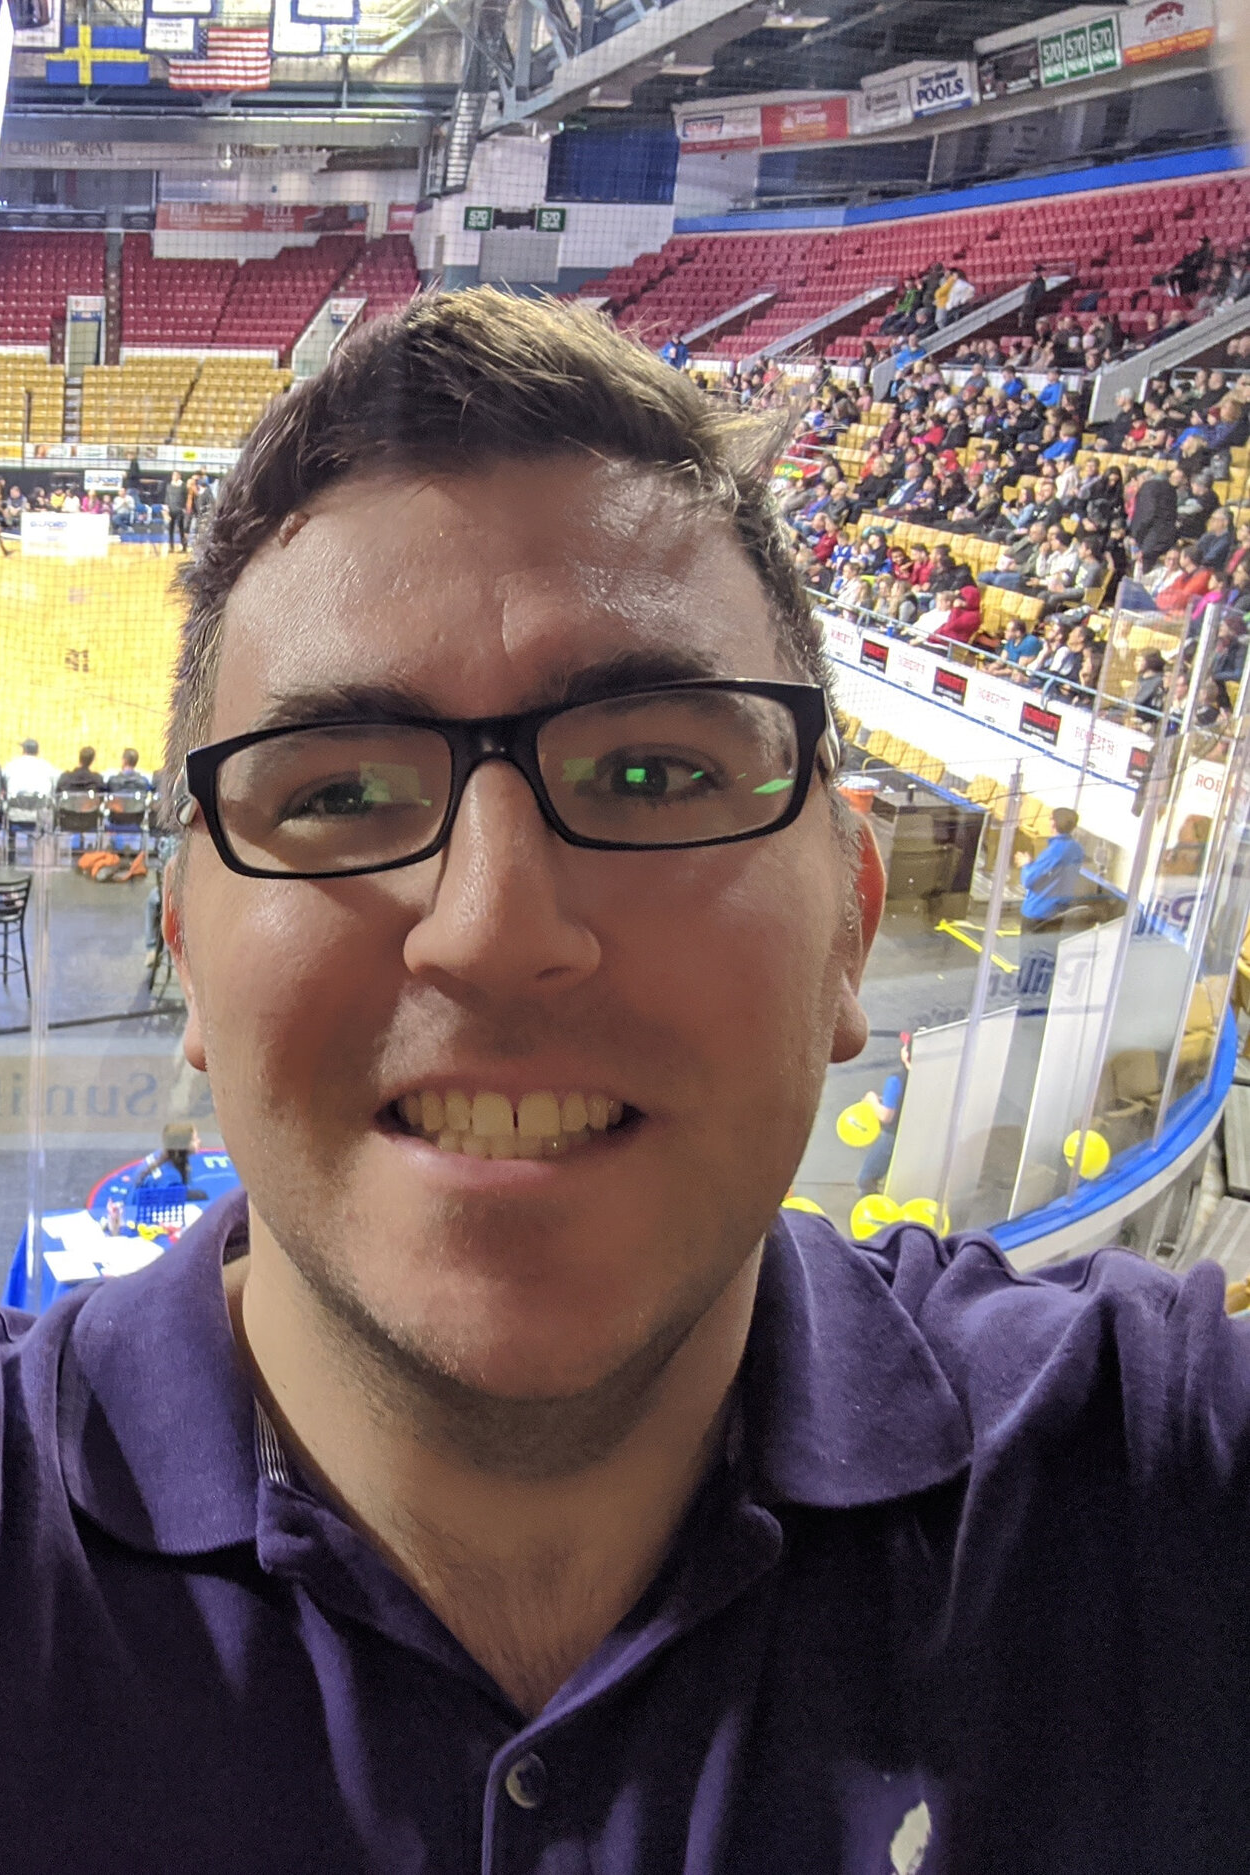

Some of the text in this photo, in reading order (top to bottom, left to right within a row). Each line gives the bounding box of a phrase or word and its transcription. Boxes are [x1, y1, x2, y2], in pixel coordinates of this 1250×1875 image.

[1066, 36, 1086, 58] 570
[1092, 27, 1113, 49] 570
[1043, 43, 1063, 64] 570
[916, 79, 964, 106] POOLS
